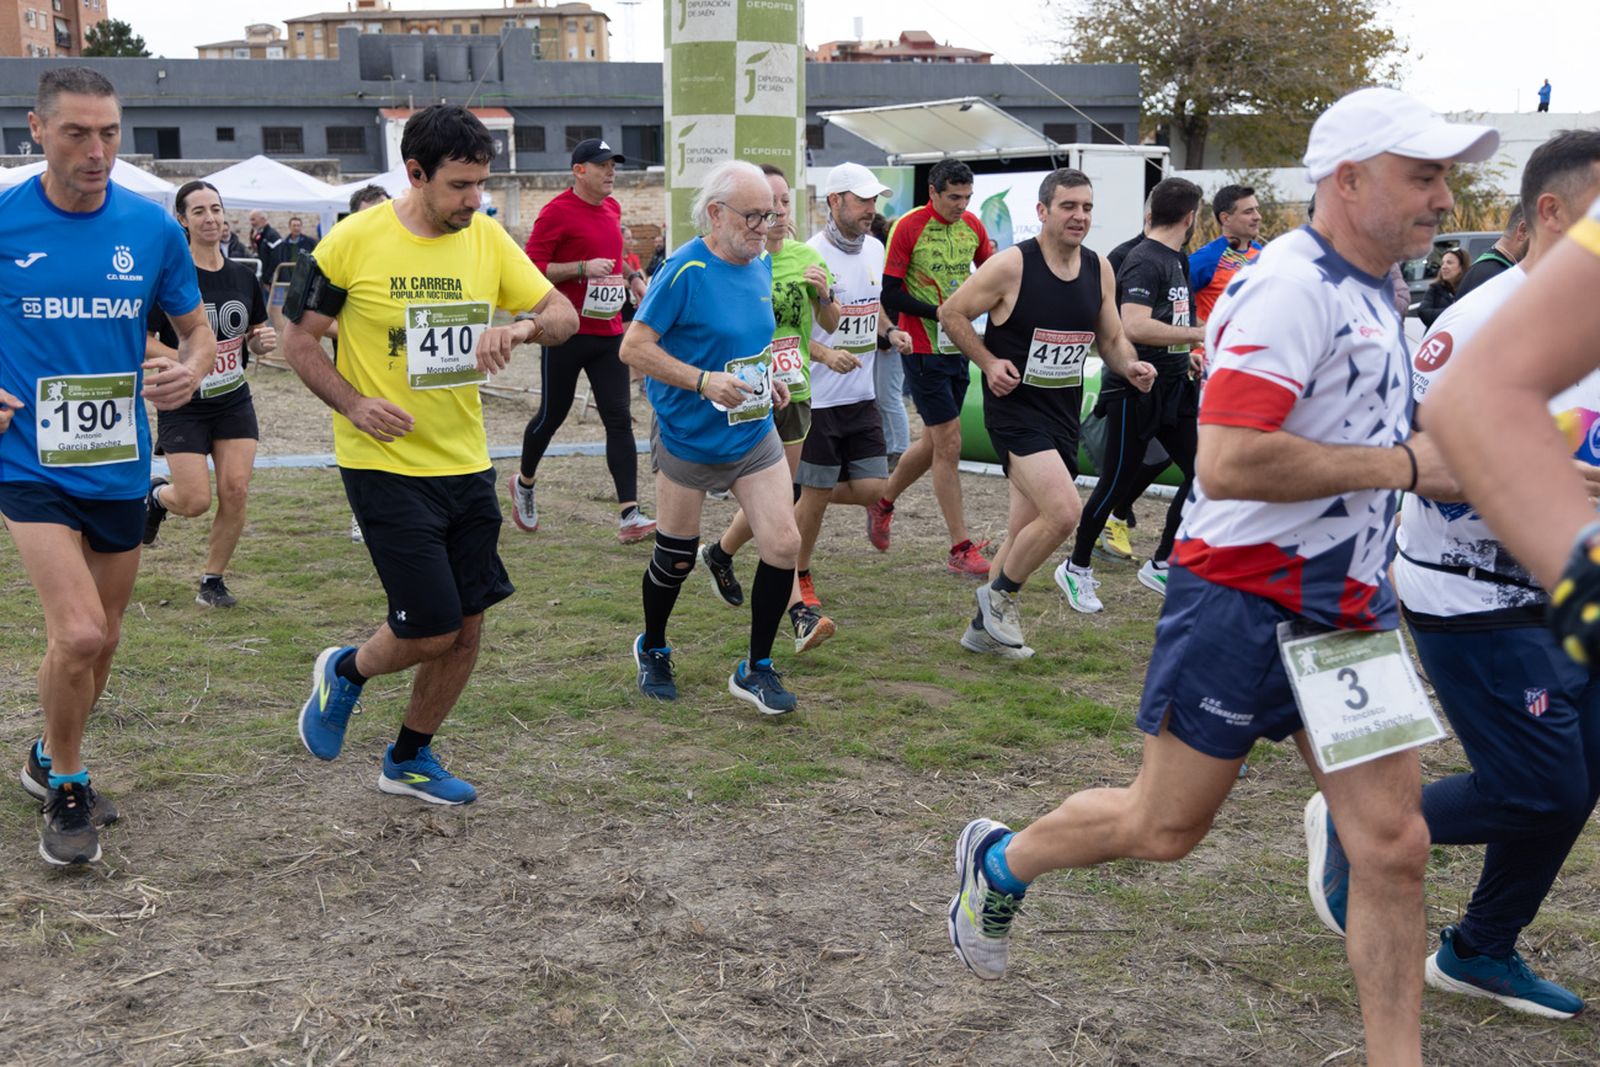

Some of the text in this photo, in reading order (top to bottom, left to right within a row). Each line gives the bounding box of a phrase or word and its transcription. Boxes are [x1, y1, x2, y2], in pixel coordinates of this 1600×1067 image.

[746, 1, 794, 11] DEPORTES
[686, 147, 728, 155] DIPUTACIÓN
[743, 147, 792, 156] DEPORTES
[390, 276, 463, 291] XX CARRERA
[390, 290, 463, 300] POPULAR NOCTURNA
[588, 286, 625, 303] 4024
[22, 297, 143, 320] CD BULEVAR
[838, 314, 876, 335] 4110
[419, 325, 473, 357] 410
[1033, 343, 1085, 366] 4122
[54, 399, 118, 434] 190
[74, 432, 103, 440] Antonio
[90, 439, 122, 450] Sanchez
[1337, 667, 1370, 711] 3
[1341, 705, 1387, 724] Francisco
[1331, 712, 1415, 743] Morales Sanchez
